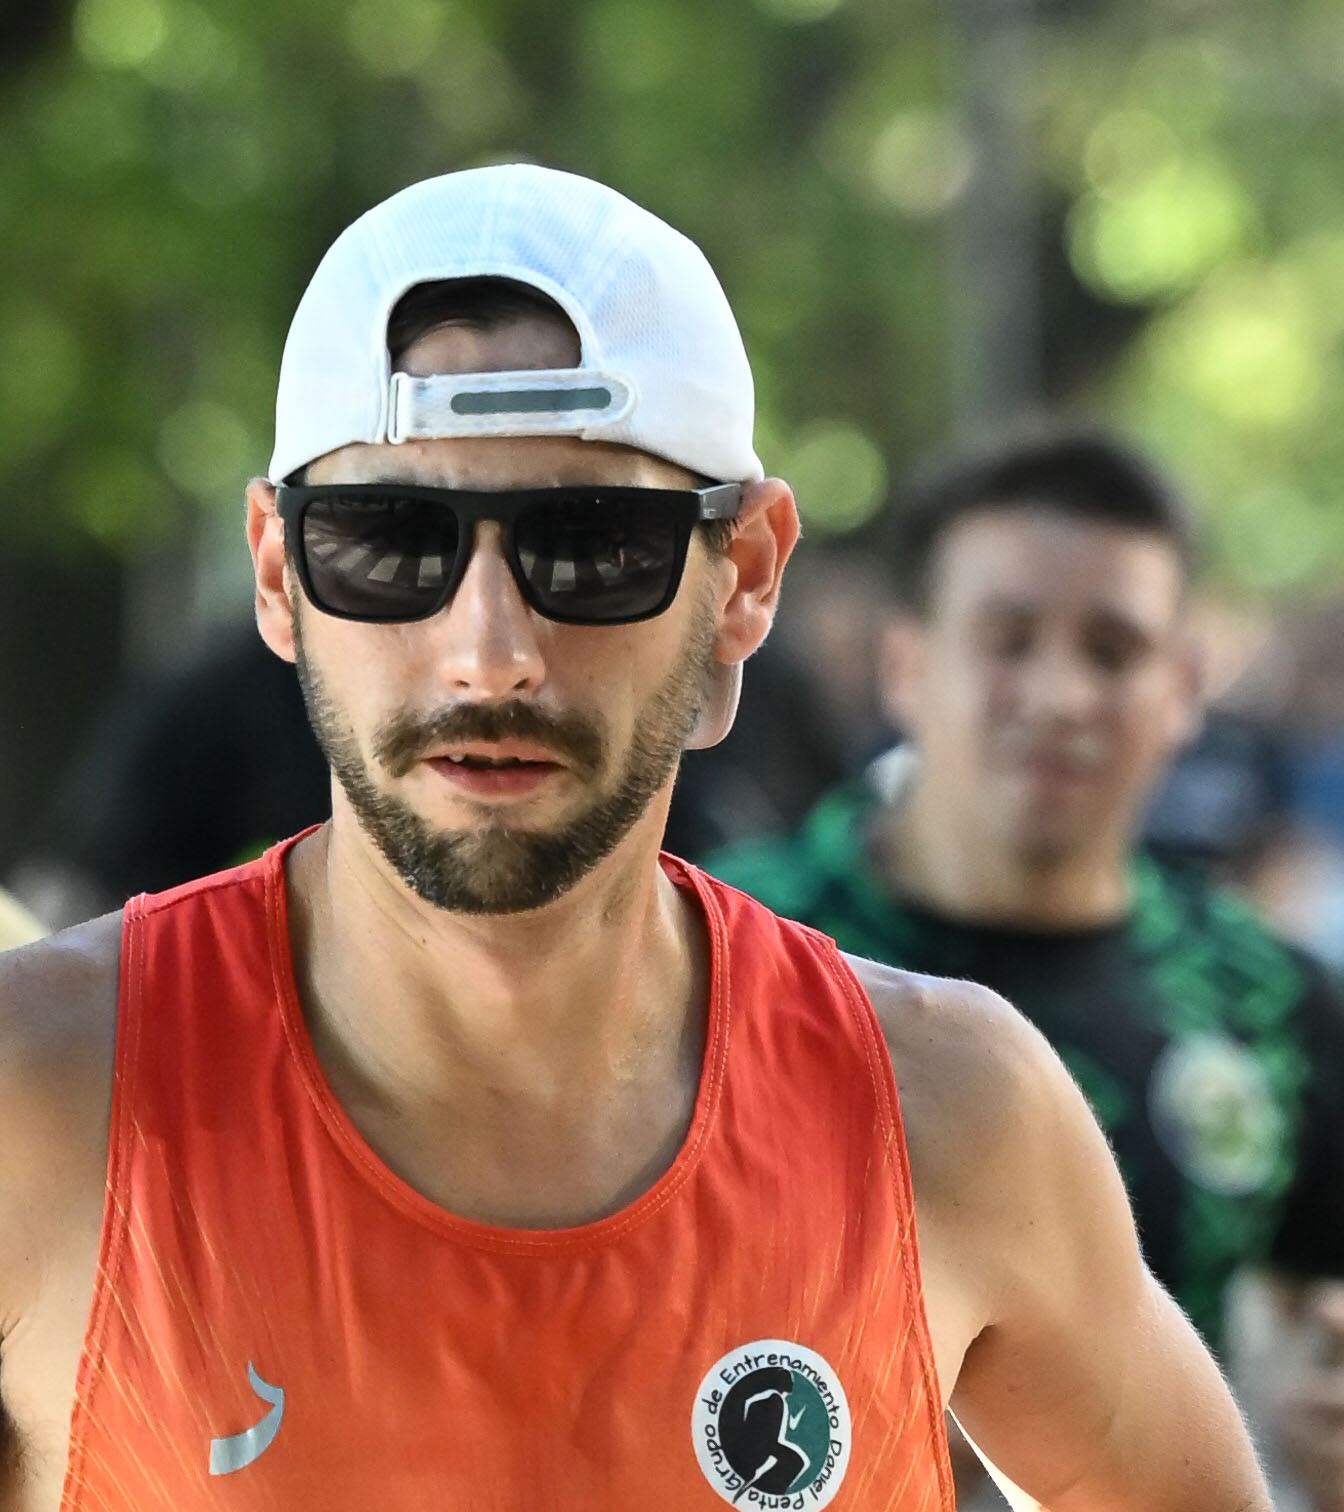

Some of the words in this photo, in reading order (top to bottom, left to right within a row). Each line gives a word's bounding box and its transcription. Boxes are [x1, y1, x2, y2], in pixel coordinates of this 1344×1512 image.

[702, 1388, 724, 1415] de
[719, 1353, 840, 1429] Entrenamiento
[704, 1424, 746, 1491] Grupo
[809, 1438, 843, 1501] Daniel
[748, 1490, 805, 1511] Penta
